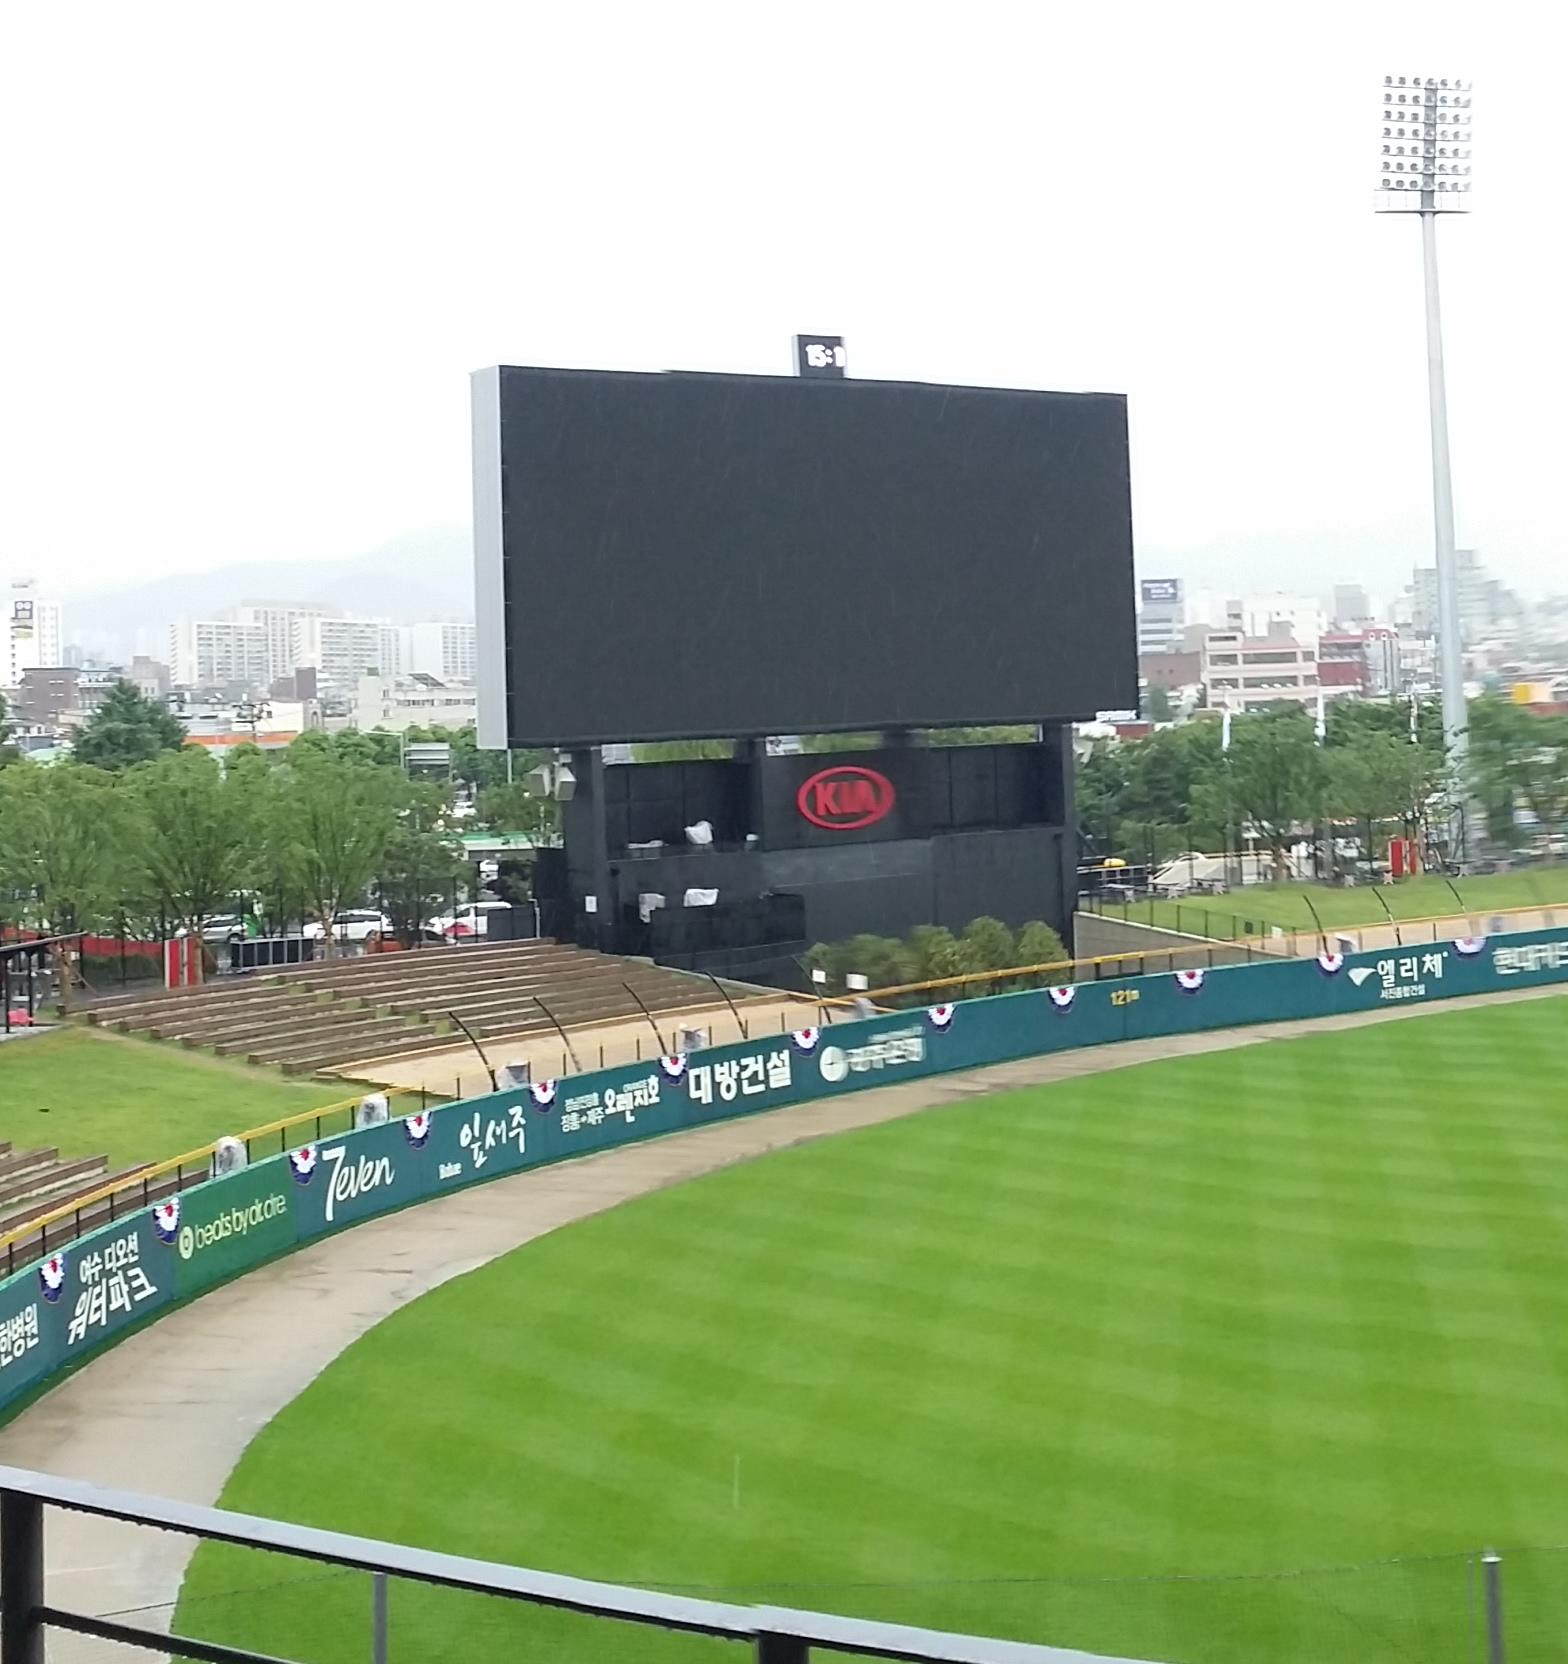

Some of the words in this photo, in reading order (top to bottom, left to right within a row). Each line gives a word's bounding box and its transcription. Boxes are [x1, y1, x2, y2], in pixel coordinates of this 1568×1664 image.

[815, 780, 876, 816] KIA
[1376, 951, 1444, 987] 엘리체
[688, 1048, 793, 1105] 대방건설
[67, 1266, 159, 1346] 워터파크
